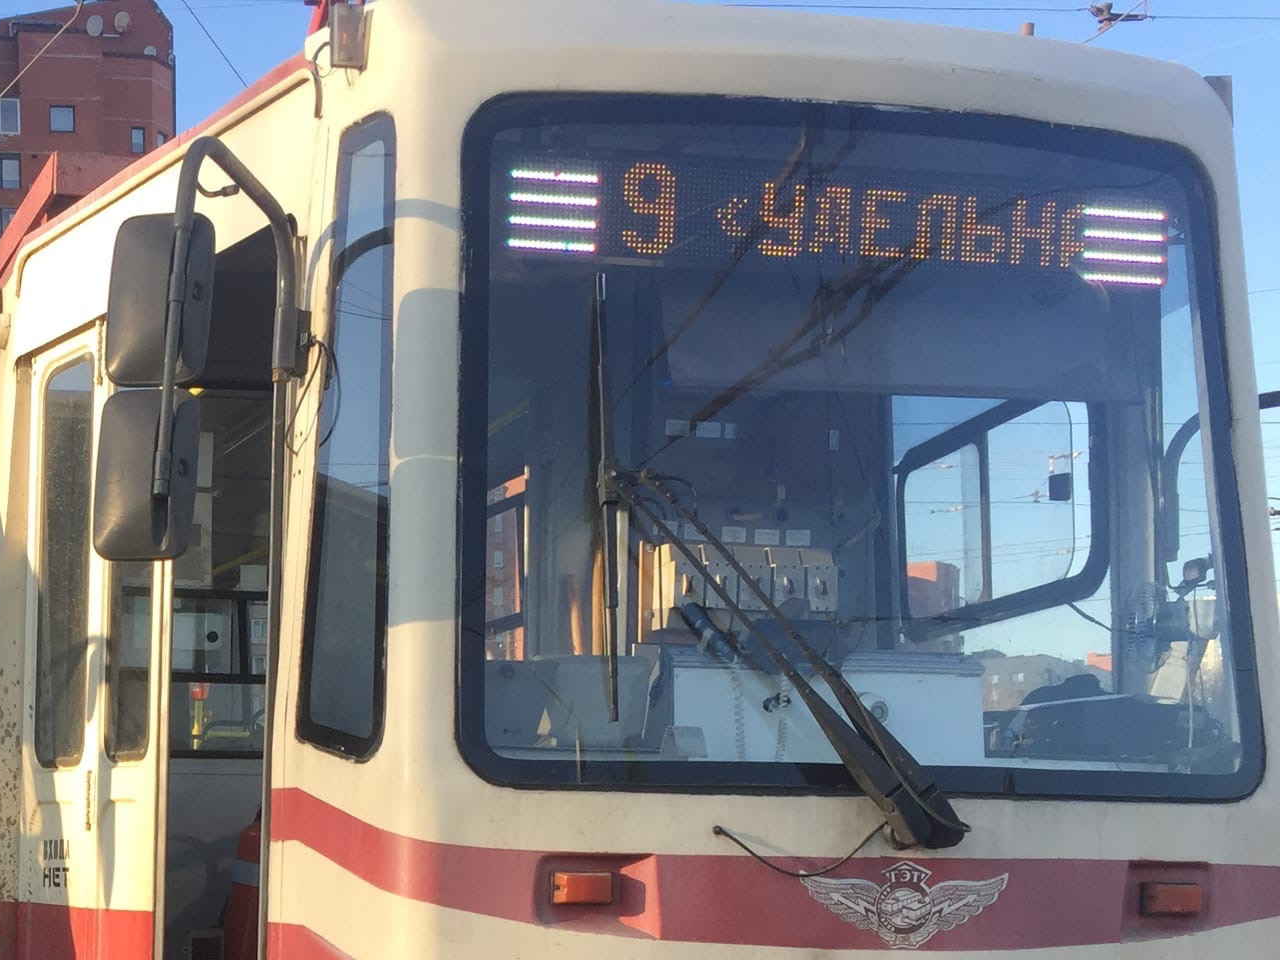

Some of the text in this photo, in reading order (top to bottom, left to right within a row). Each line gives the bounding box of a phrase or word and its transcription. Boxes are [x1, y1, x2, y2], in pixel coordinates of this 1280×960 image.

[623, 163, 676, 254] 9
[43, 839, 70, 860] ВХОДА
[42, 866, 70, 888] НЕТ
[889, 870, 921, 883] ГЭТ
